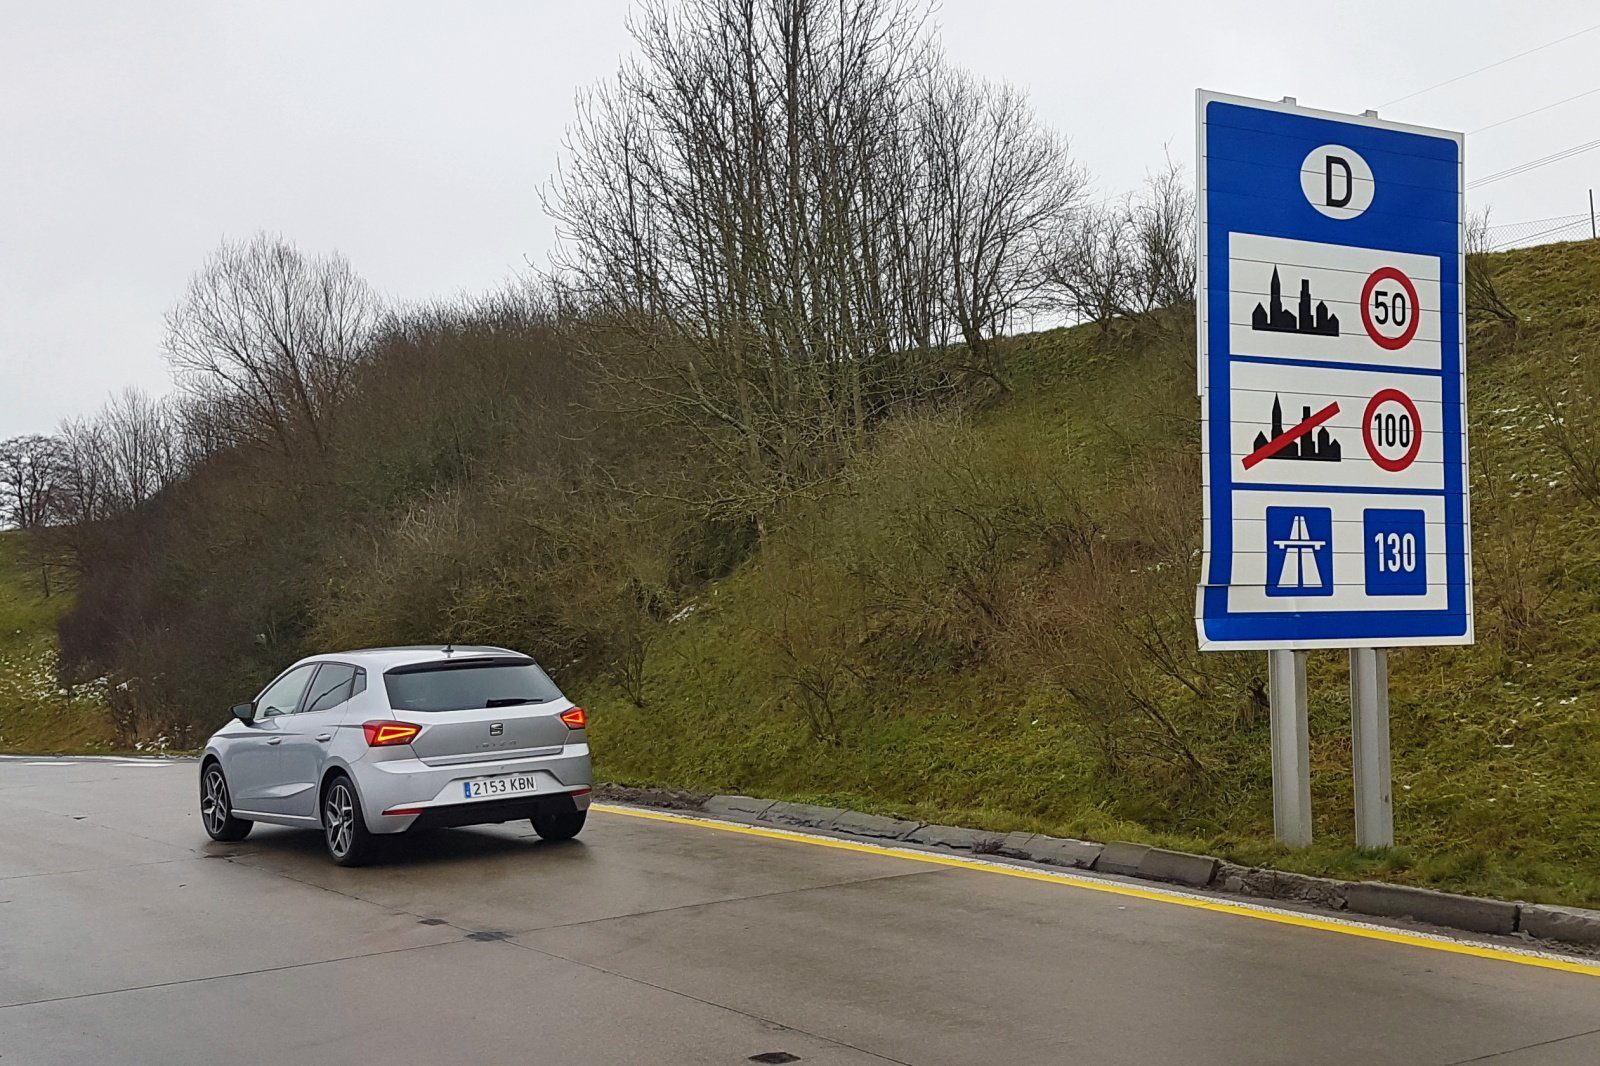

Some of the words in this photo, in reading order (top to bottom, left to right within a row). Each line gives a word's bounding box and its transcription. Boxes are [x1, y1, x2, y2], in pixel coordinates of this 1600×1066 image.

[1326, 155, 1352, 208] D
[1374, 290, 1406, 327] 50
[1374, 413, 1410, 448] 100
[1374, 532, 1416, 573] 130
[473, 780, 506, 795] 2153
[510, 776, 535, 791] KBN
